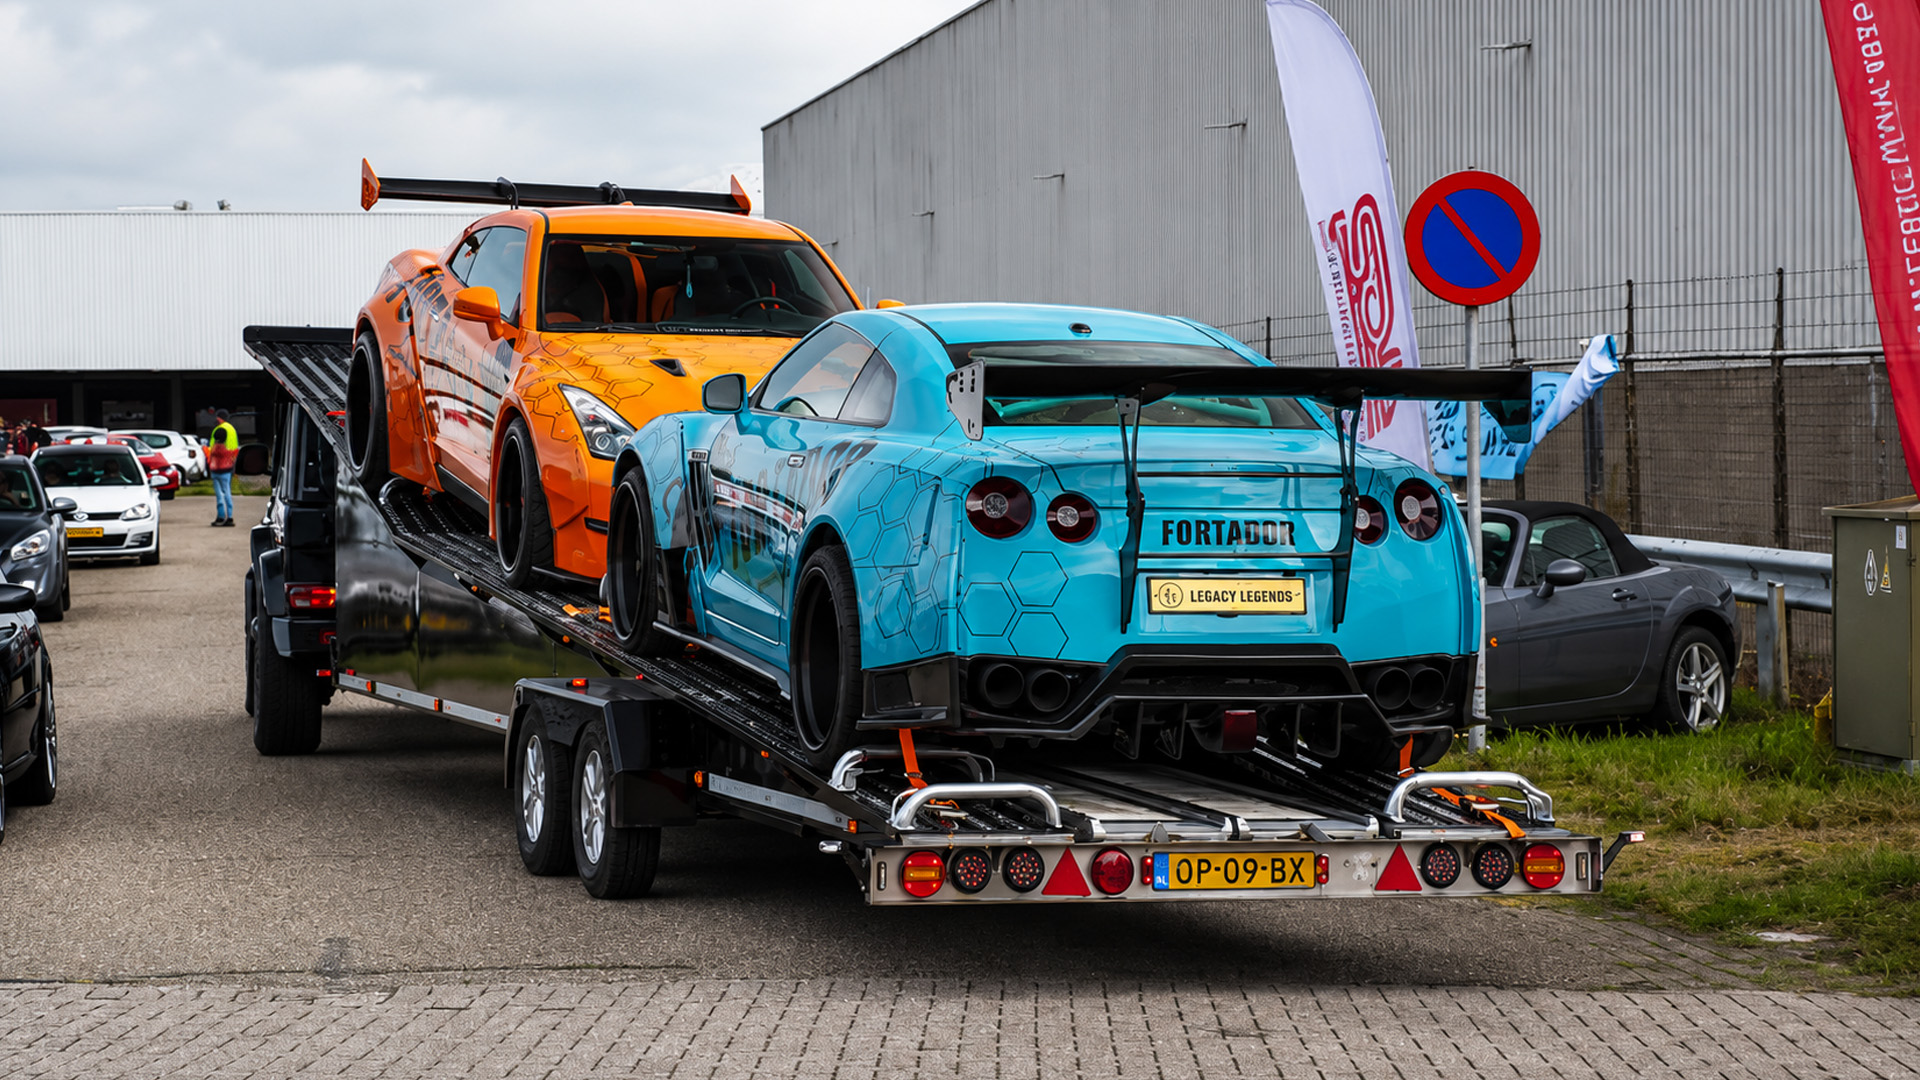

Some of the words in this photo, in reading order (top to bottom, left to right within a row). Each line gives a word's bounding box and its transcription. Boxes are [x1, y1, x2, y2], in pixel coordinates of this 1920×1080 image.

[1162, 519, 1296, 546] FORTADOR
[1190, 590, 1236, 603] LEGACY
[1240, 590, 1293, 603] LEGENDS
[1176, 857, 1305, 884] OP-09-BX
